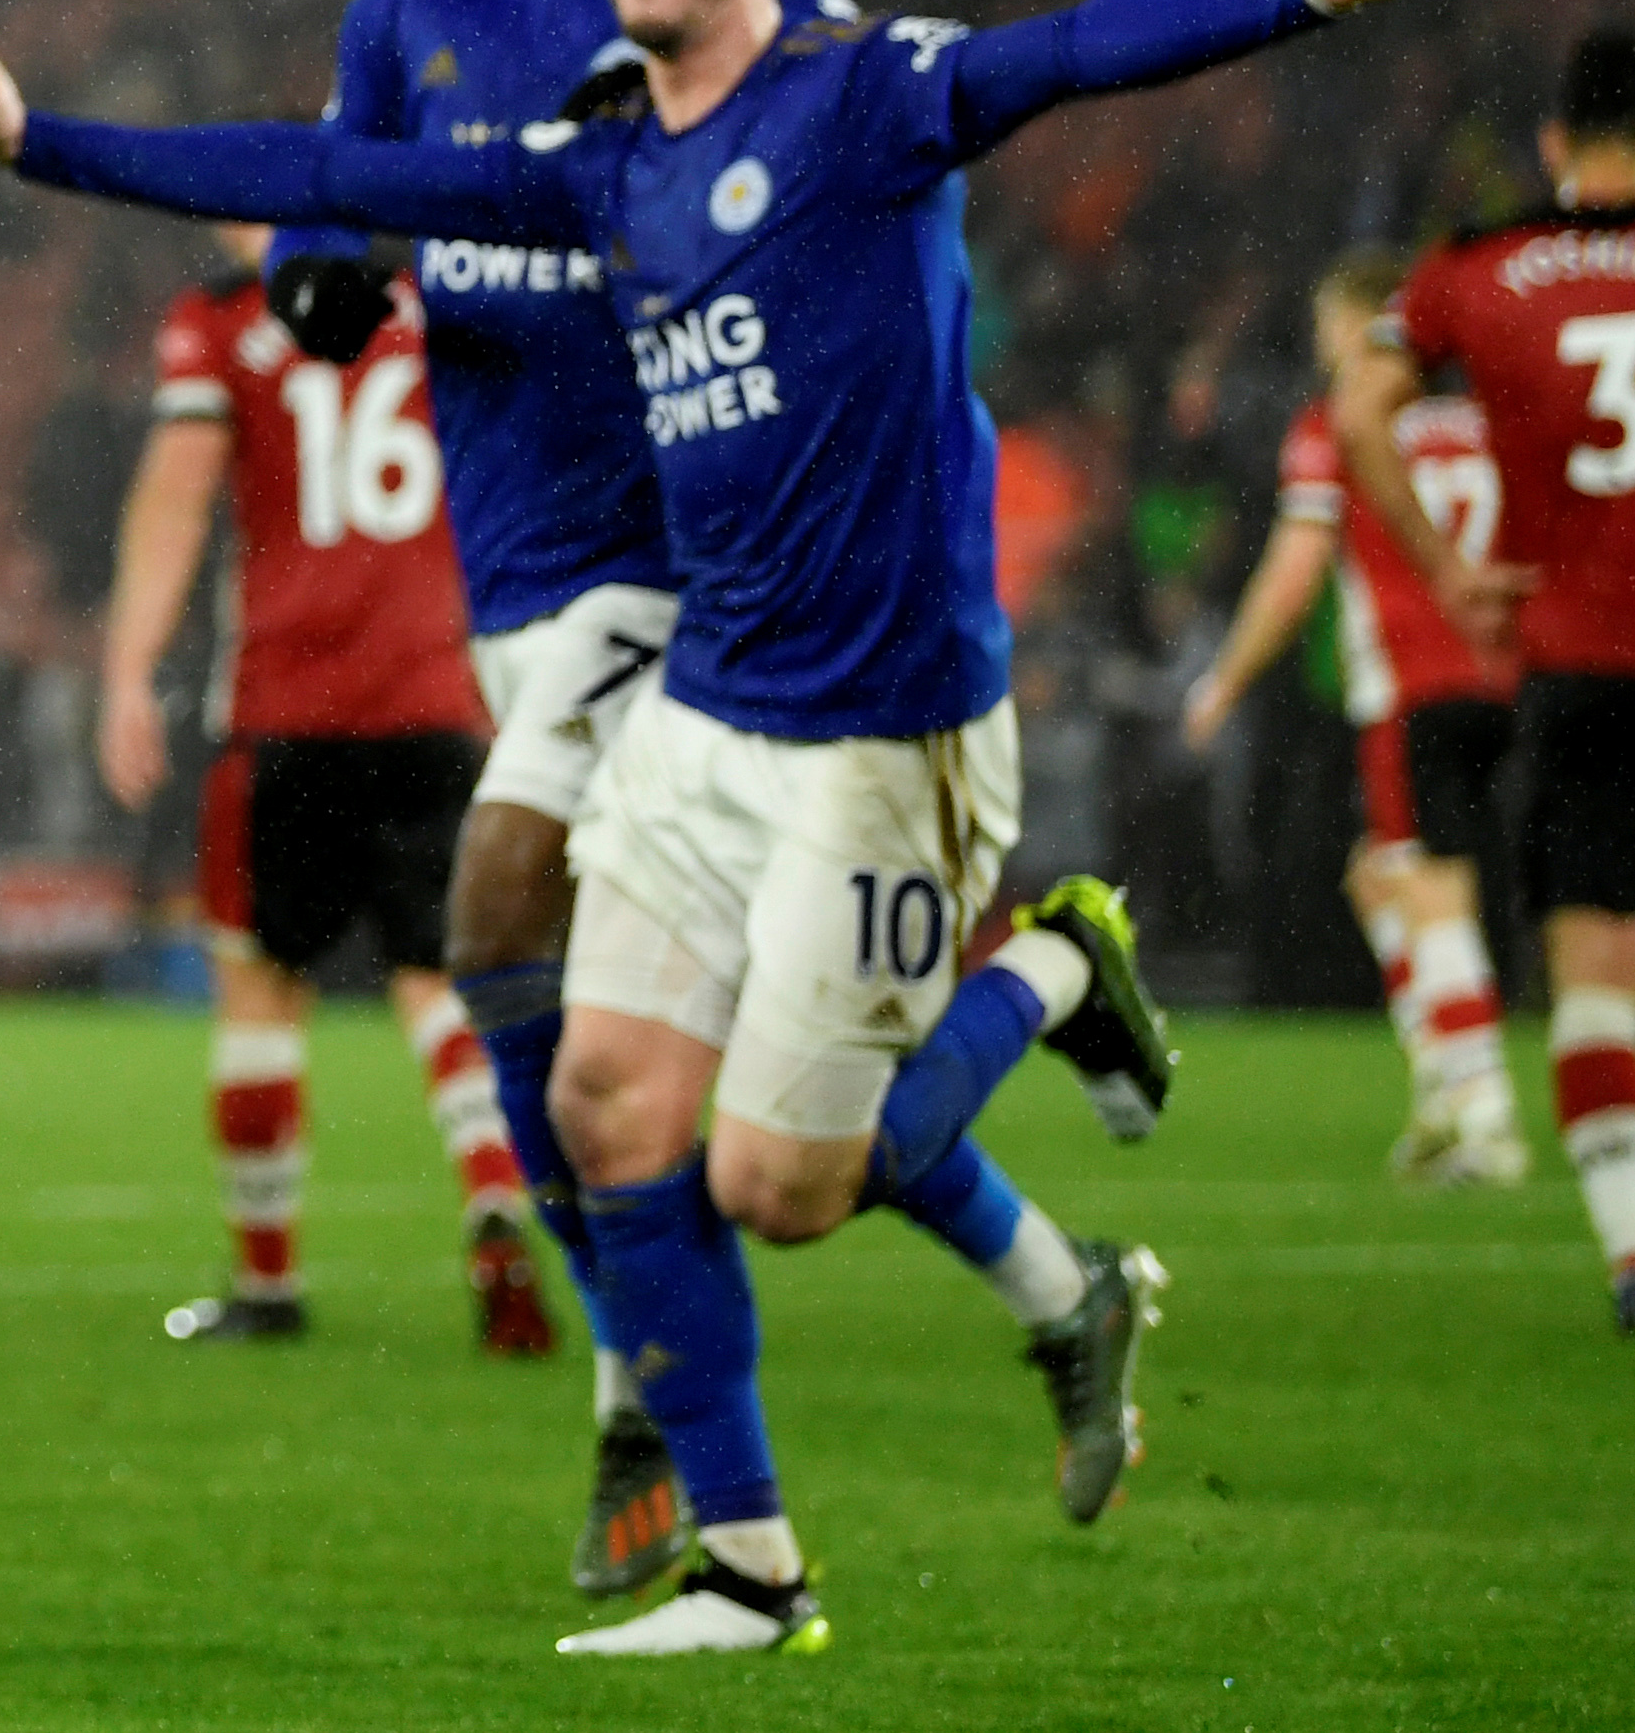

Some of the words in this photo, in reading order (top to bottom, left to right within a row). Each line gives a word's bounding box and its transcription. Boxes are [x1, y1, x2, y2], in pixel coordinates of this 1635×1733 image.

[280, 353, 443, 549] 16
[578, 631, 662, 705] 7
[850, 872, 943, 982] 10
